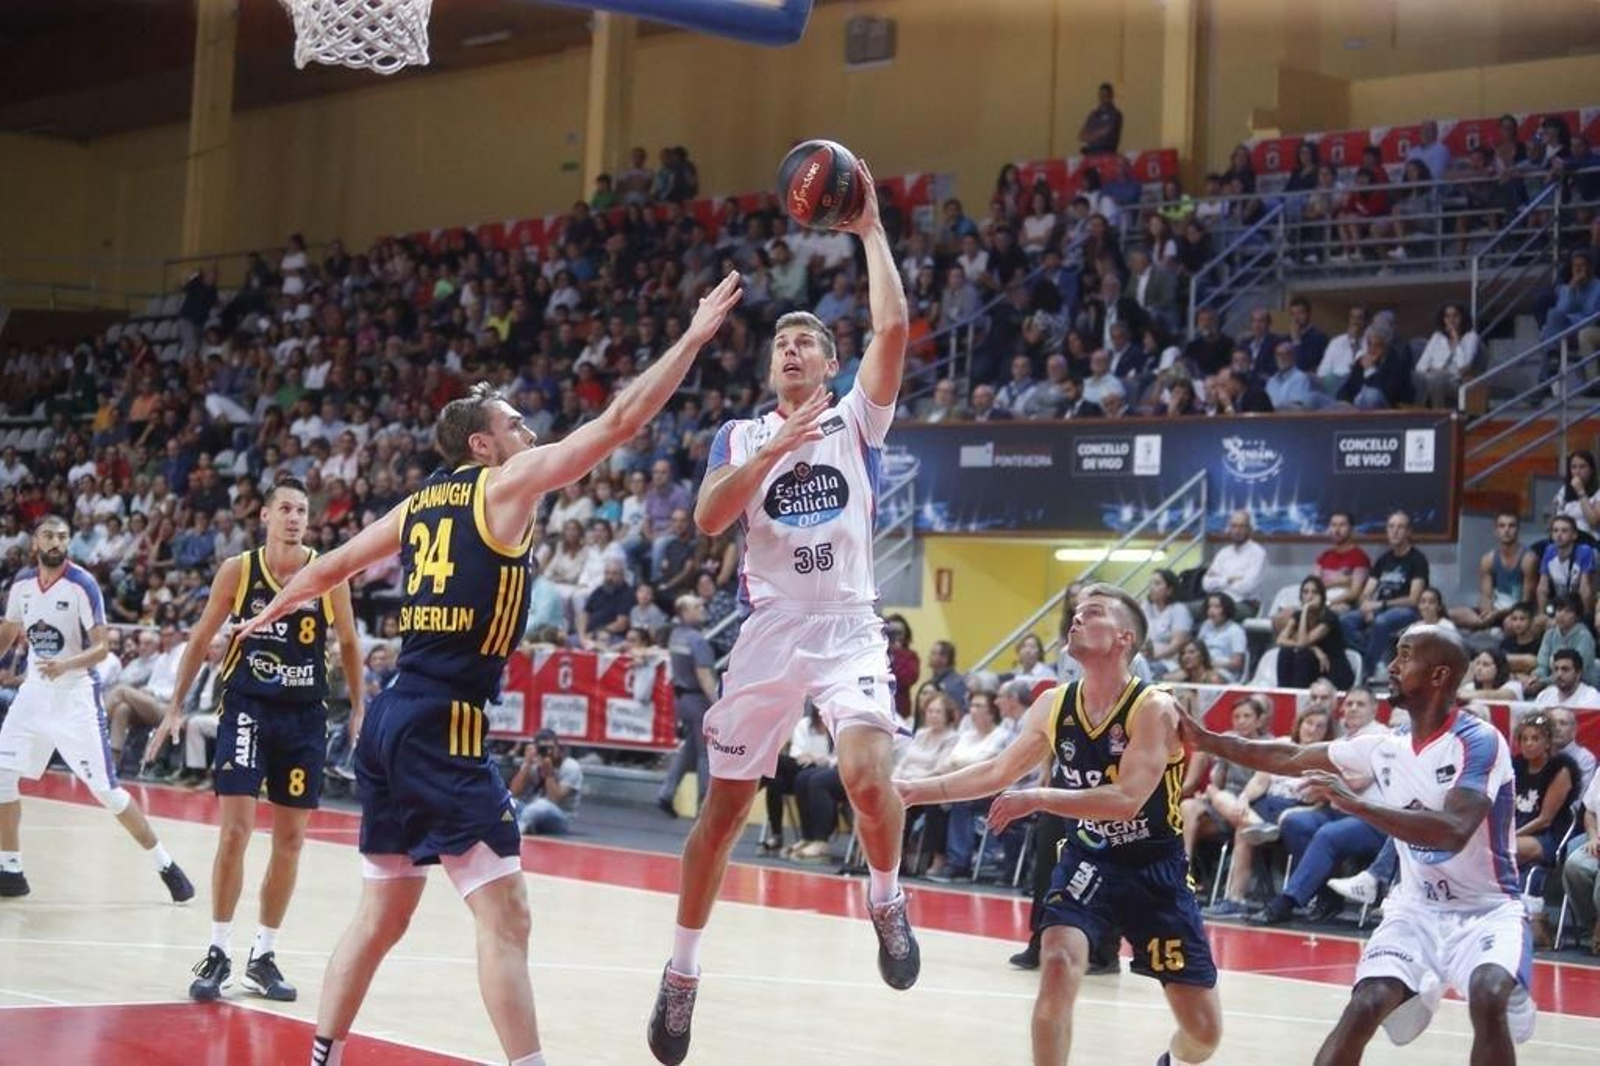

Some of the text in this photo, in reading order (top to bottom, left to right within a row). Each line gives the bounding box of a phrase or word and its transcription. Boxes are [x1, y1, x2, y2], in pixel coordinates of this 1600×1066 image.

[1077, 442, 1129, 456] CONCELLO
[1339, 437, 1399, 452] CONCELLO
[1082, 457, 1096, 470] DE
[1097, 456, 1124, 470] VIGO
[1345, 452, 1392, 468] DE VIGO
[775, 474, 839, 499] Estrella
[778, 492, 839, 515] Galicia
[407, 517, 455, 595] 34
[794, 543, 834, 574] 35
[299, 615, 316, 645] 8
[413, 605, 475, 632] BERLIN
[235, 727, 251, 767] ALBA
[289, 768, 306, 797] 8
[1147, 937, 1185, 971] 15
